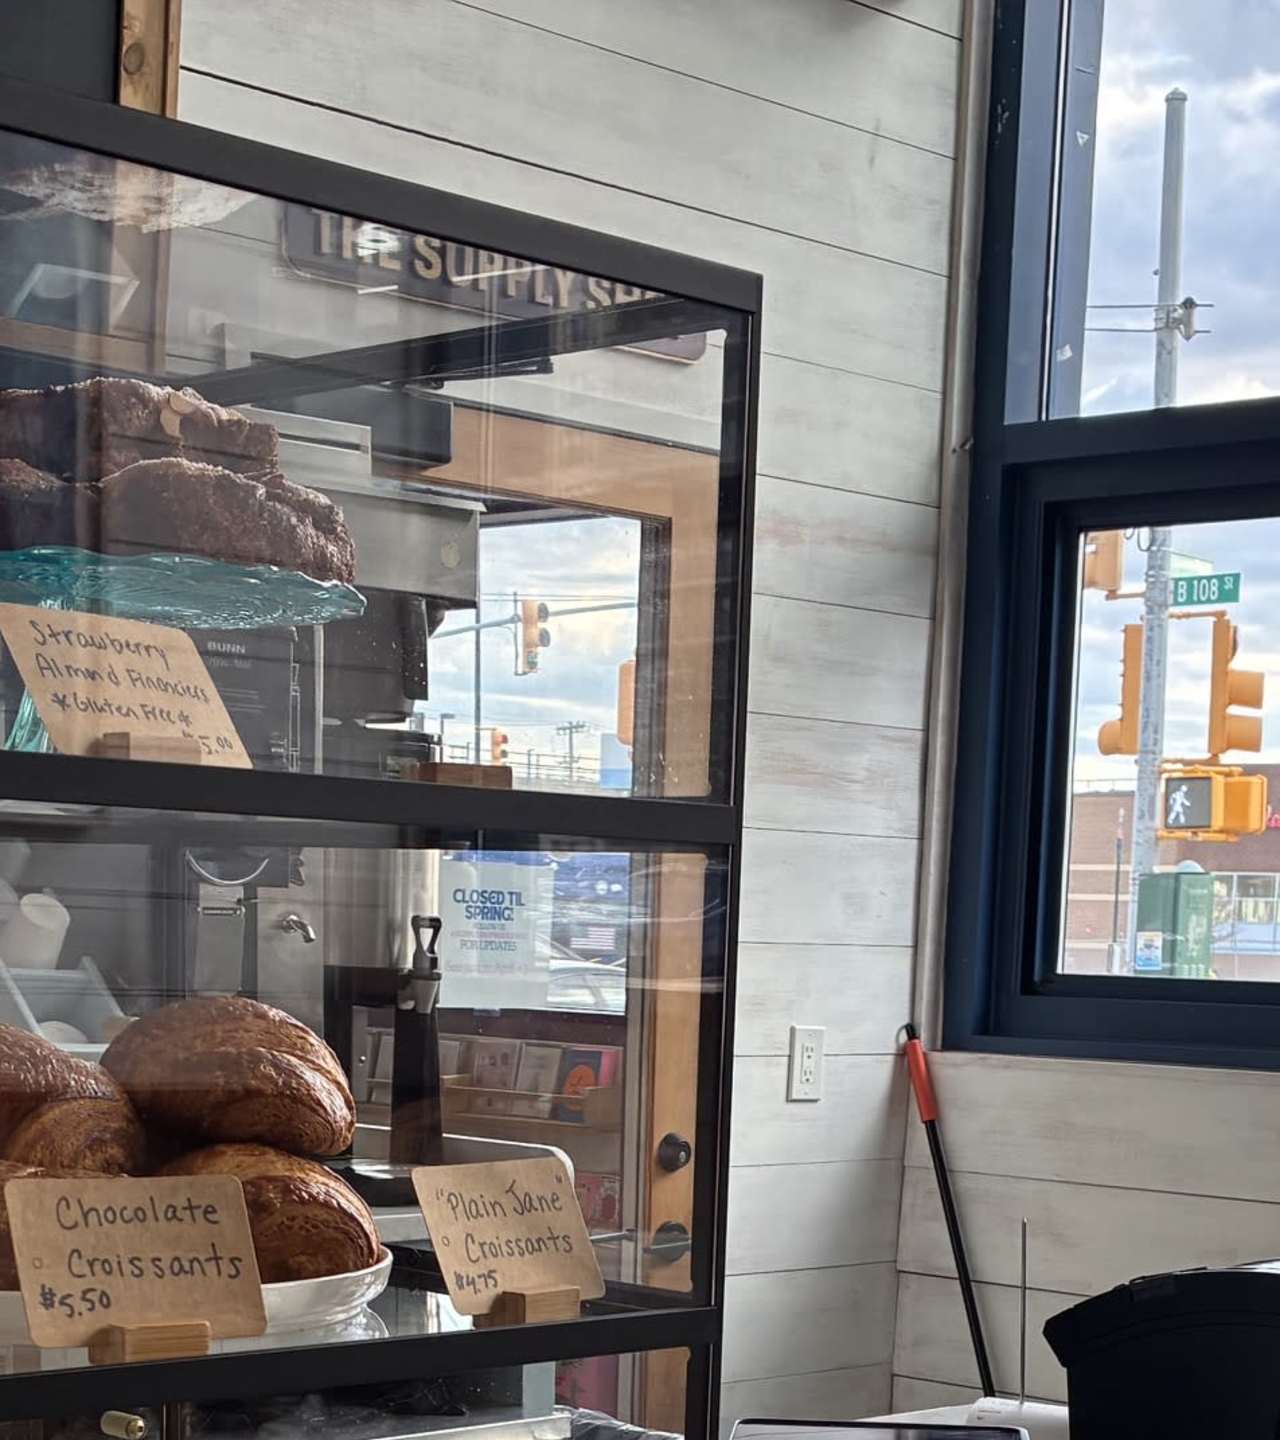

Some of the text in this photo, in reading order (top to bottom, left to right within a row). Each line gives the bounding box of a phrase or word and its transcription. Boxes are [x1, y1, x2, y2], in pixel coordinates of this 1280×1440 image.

[1177, 580, 1187, 602] B
[1193, 578, 1219, 602] 108
[28, 620, 171, 671] Strawberry
[207, 641, 246, 654] BUNN
[35, 652, 210, 705] Almond Financiers
[452, 888, 526, 907] CLOSED TIL
[55, 1195, 221, 1232] Chocolate
[66, 1242, 244, 1281] Croissants
[464, 1225, 574, 1265] Croissants
[38, 1283, 113, 1319] $5.50
